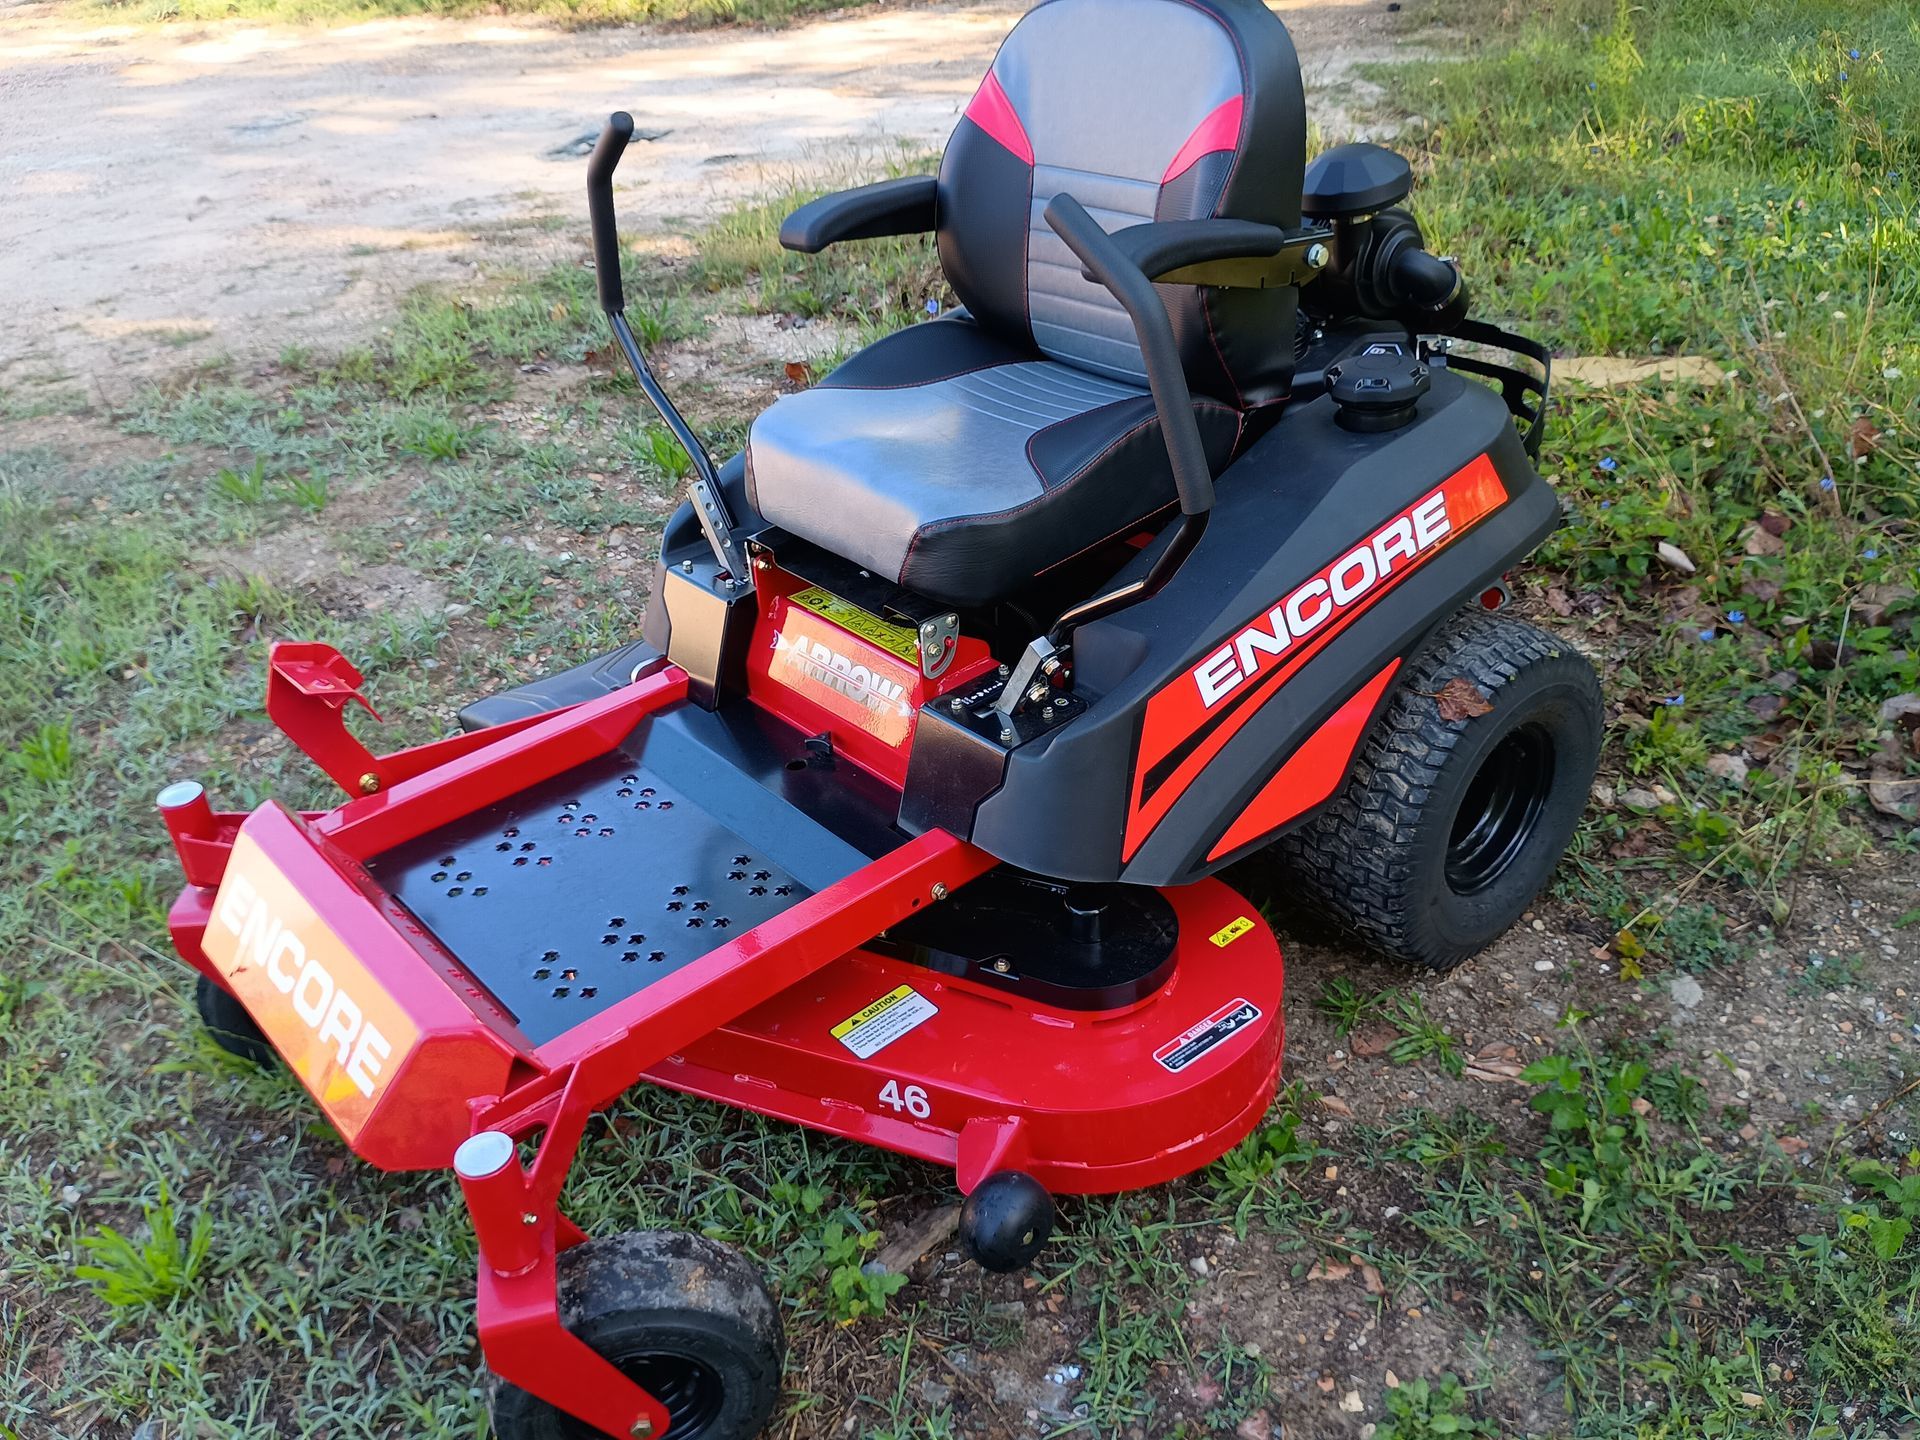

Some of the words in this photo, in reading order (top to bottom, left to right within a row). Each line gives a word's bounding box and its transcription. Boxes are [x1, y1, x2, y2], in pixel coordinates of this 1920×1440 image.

[1193, 490, 1452, 709] ENCORE
[786, 635, 904, 712] ARROW
[218, 873, 392, 1098] ENCORE
[862, 993, 898, 1018] CAUTION
[1187, 1019, 1215, 1039] DANGER
[878, 1079, 931, 1119] 46
